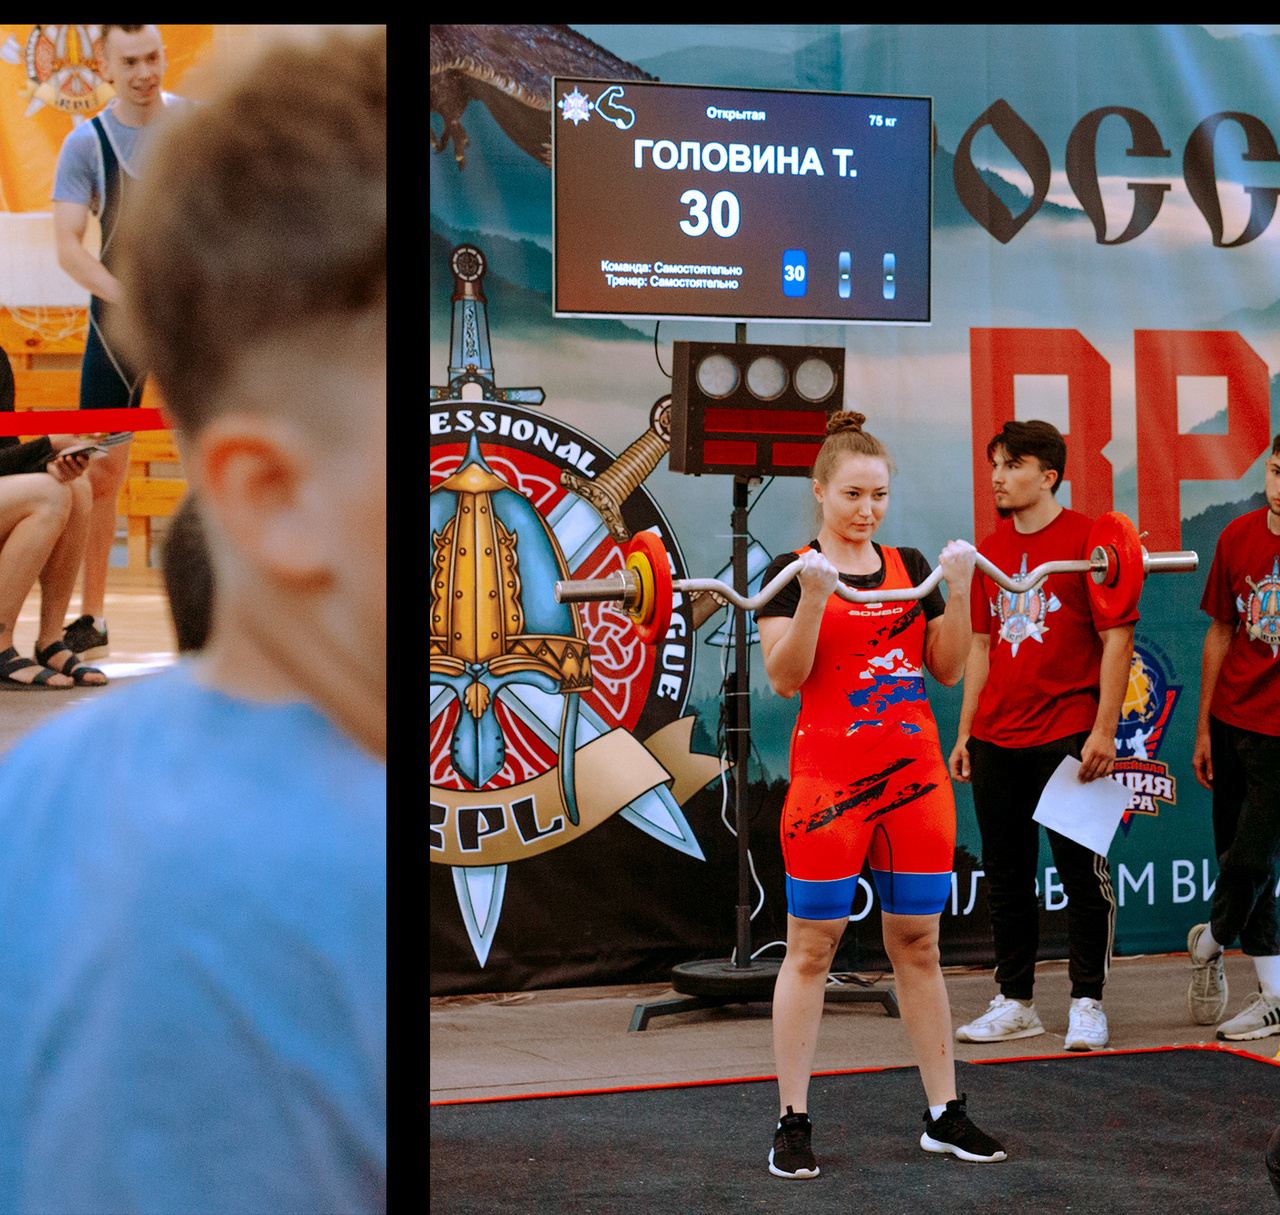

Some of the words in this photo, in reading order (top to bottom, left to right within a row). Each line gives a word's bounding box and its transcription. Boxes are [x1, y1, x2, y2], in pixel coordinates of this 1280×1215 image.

[706, 106, 766, 122] Открытая
[869, 114, 883, 127] 75
[885, 117, 897, 128] кг
[634, 139, 824, 176] ГОЛОВИНА
[832, 149, 858, 177] Т.
[679, 189, 740, 237] 30
[601, 260, 652, 274] Команда:
[653, 261, 743, 276] Самостоятельно
[784, 265, 805, 282] 30
[606, 274, 648, 289] Тренер:
[650, 275, 739, 289] Самостоятельно
[1113, 760, 1165, 775] НЕЙШАЯ
[1108, 772, 1173, 800] ЦИЯ
[1126, 794, 1155, 812] РА
